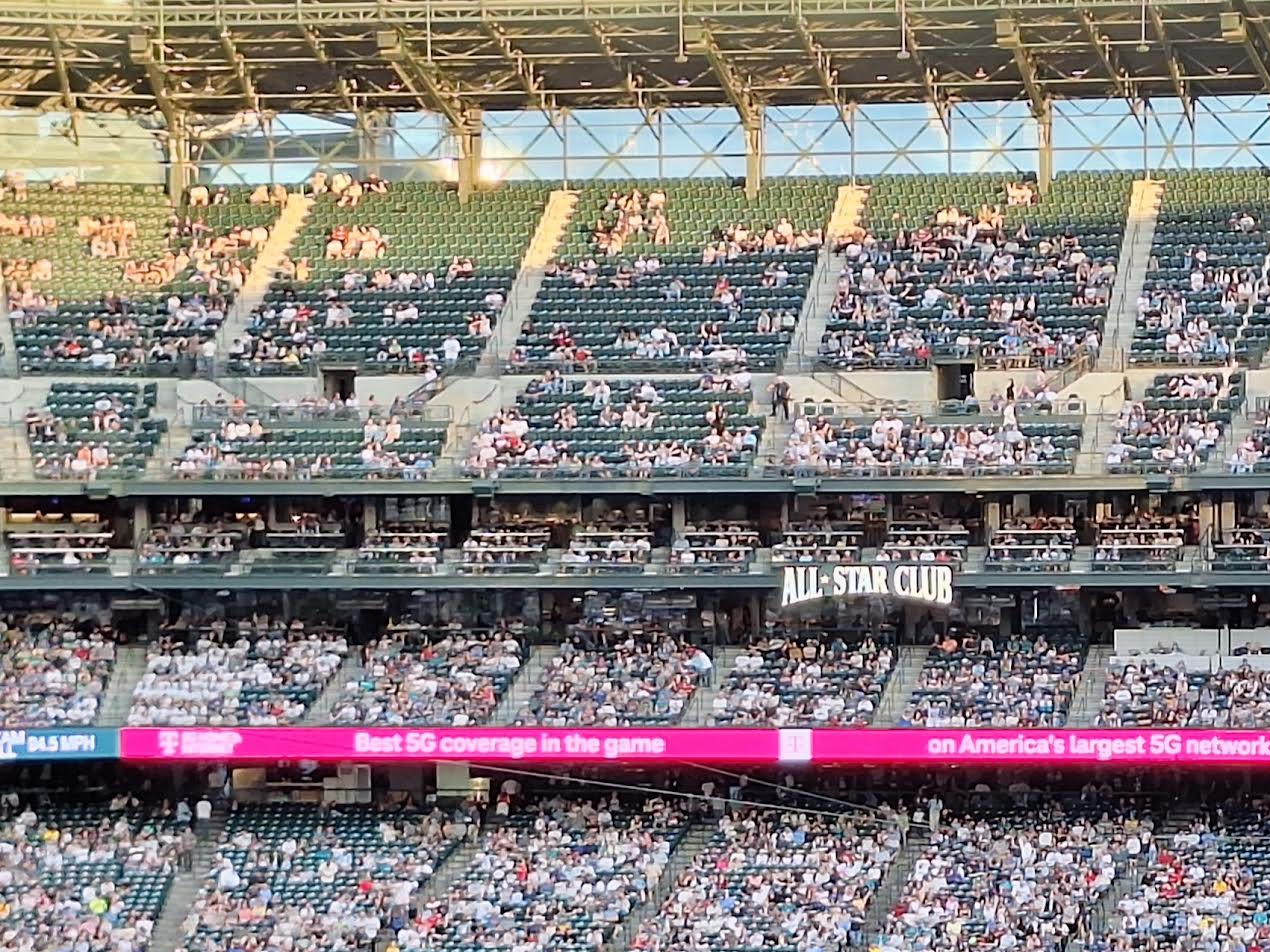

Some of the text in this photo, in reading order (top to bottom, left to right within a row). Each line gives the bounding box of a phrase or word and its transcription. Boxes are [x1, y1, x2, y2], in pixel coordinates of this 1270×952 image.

[782, 566, 953, 606] ALL STAR CLUB
[60, 734, 95, 751] MPH
[355, 733, 665, 758] Best 5G coverage in the game
[928, 737, 955, 753] on
[959, 734, 1065, 754] America's
[1070, 734, 1146, 760] largest
[1149, 734, 1182, 754] 5G
